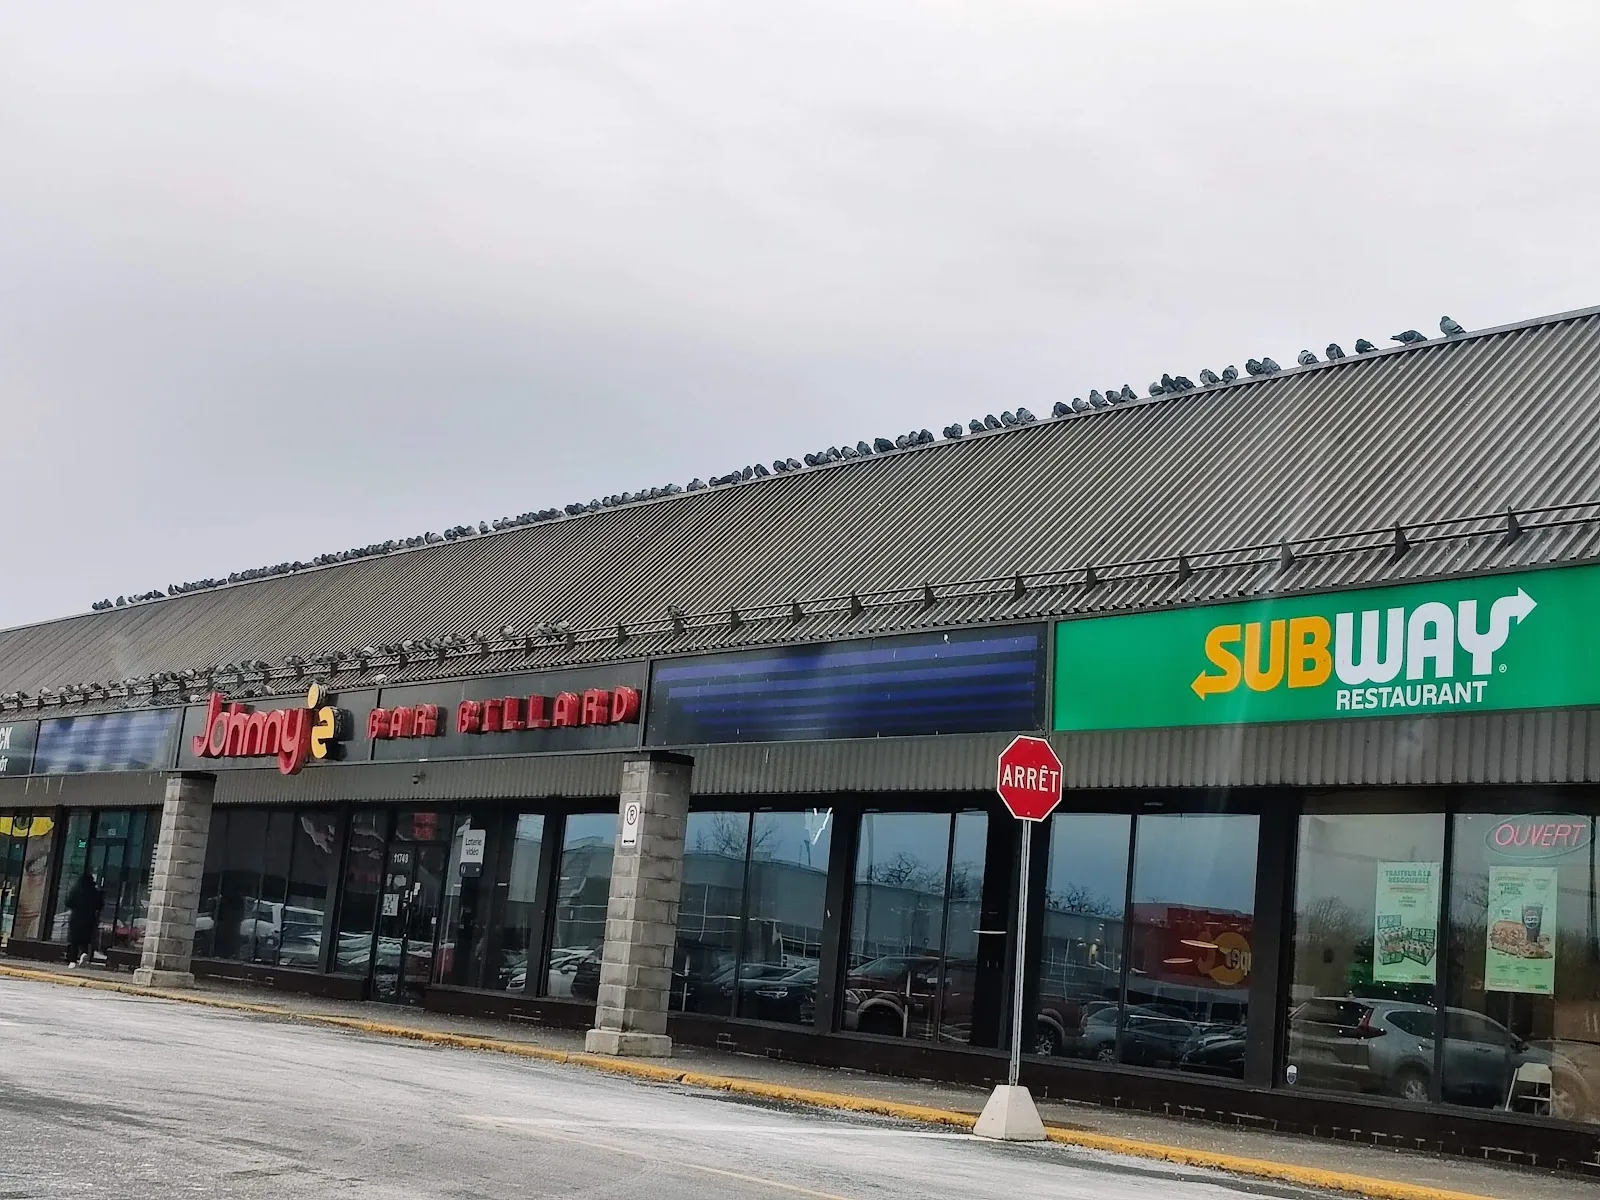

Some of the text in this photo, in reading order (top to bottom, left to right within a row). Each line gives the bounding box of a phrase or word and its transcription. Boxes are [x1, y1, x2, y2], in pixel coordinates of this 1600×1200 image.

[1190, 587, 1538, 701] SUBWAY
[1336, 681, 1488, 710] RESTAURANT
[368, 685, 638, 740] BAR BILLARD
[1002, 764, 1059, 793] ARRÊT
[1495, 823, 1587, 846] OUVERT
